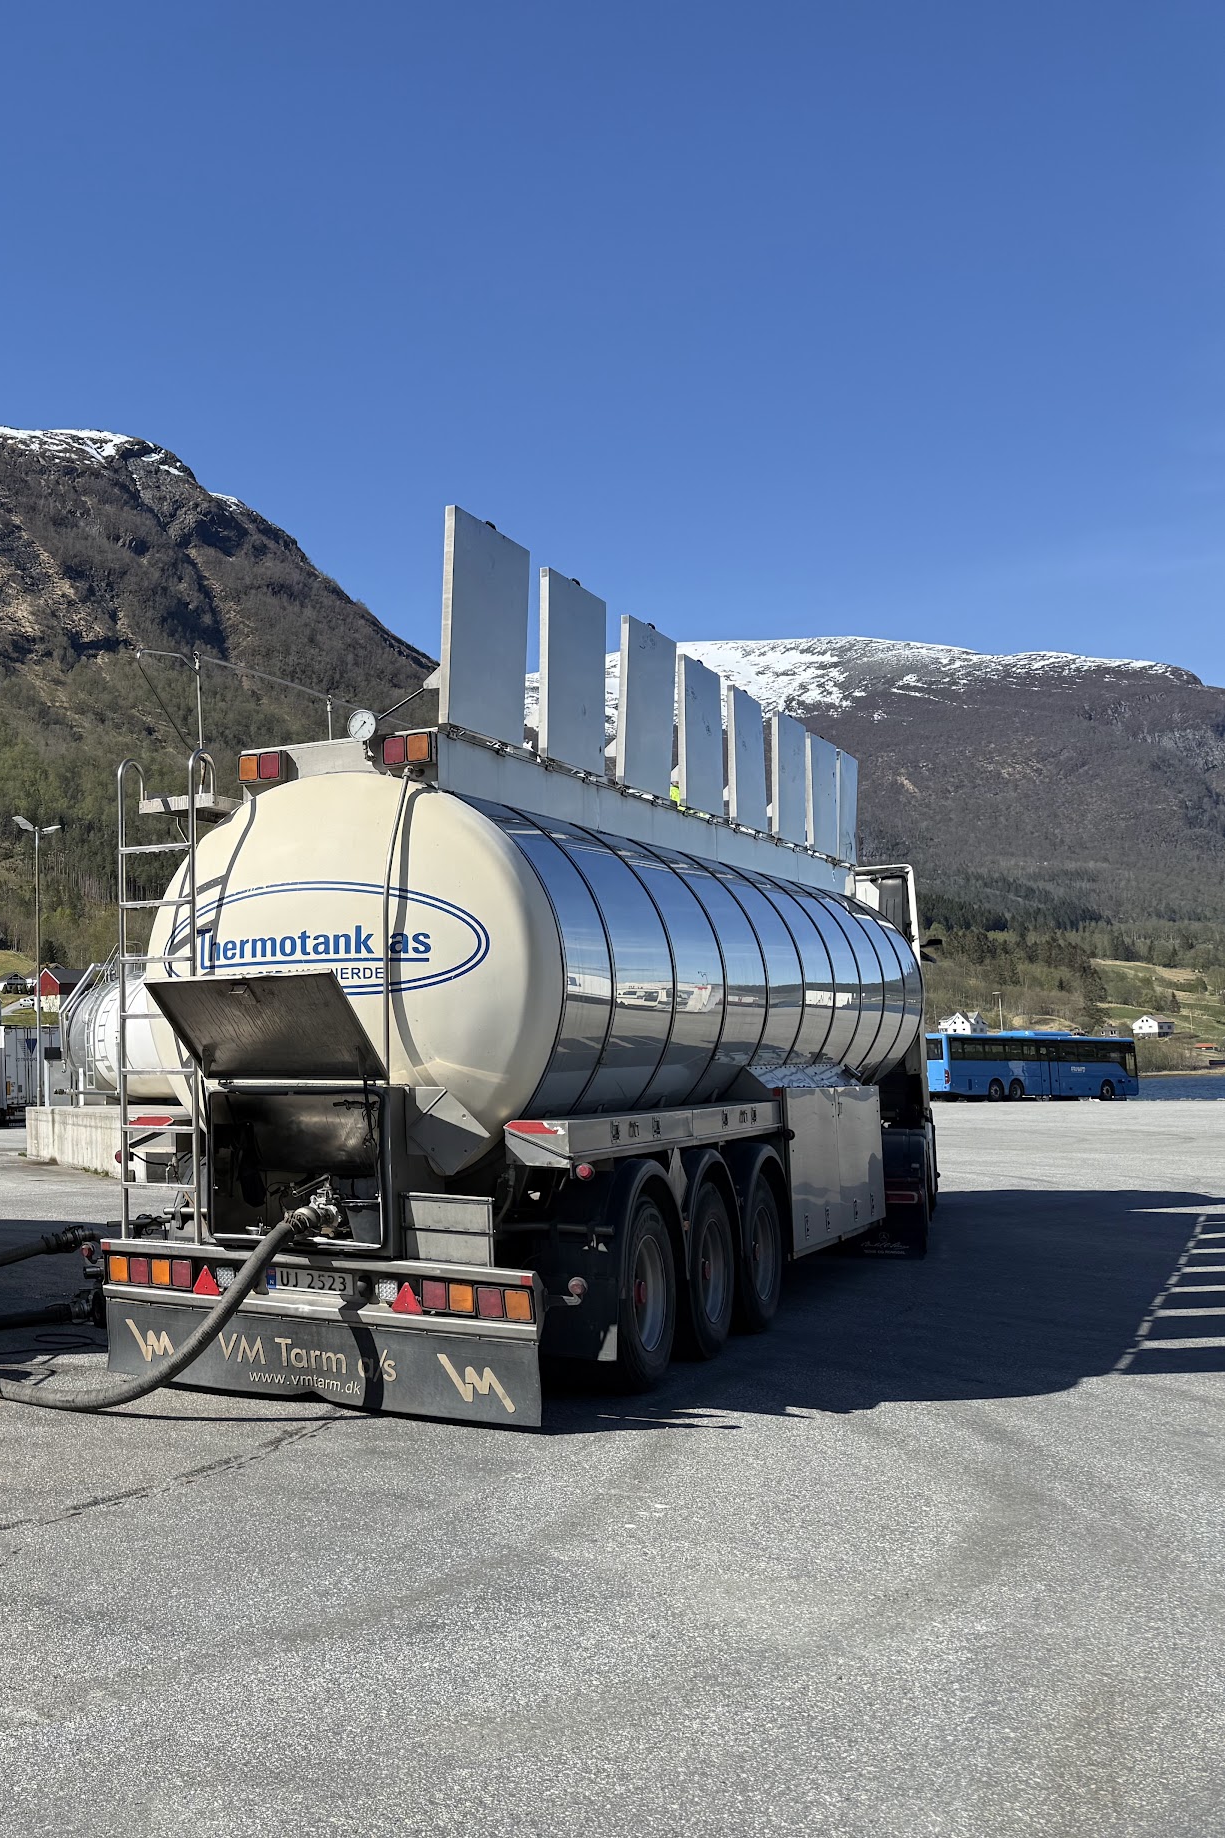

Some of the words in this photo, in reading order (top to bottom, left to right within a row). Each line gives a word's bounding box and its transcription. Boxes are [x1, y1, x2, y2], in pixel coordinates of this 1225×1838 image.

[197, 925, 375, 964] Thermotank
[390, 931, 432, 955] as
[280, 1270, 299, 1288] UJ
[306, 1273, 347, 1292] 2523
[218, 1332, 267, 1366] VM
[274, 1337, 348, 1374] Tarm
[357, 1349, 397, 1382] a/s
[249, 1371, 361, 1395] www.vmtarm.dk
